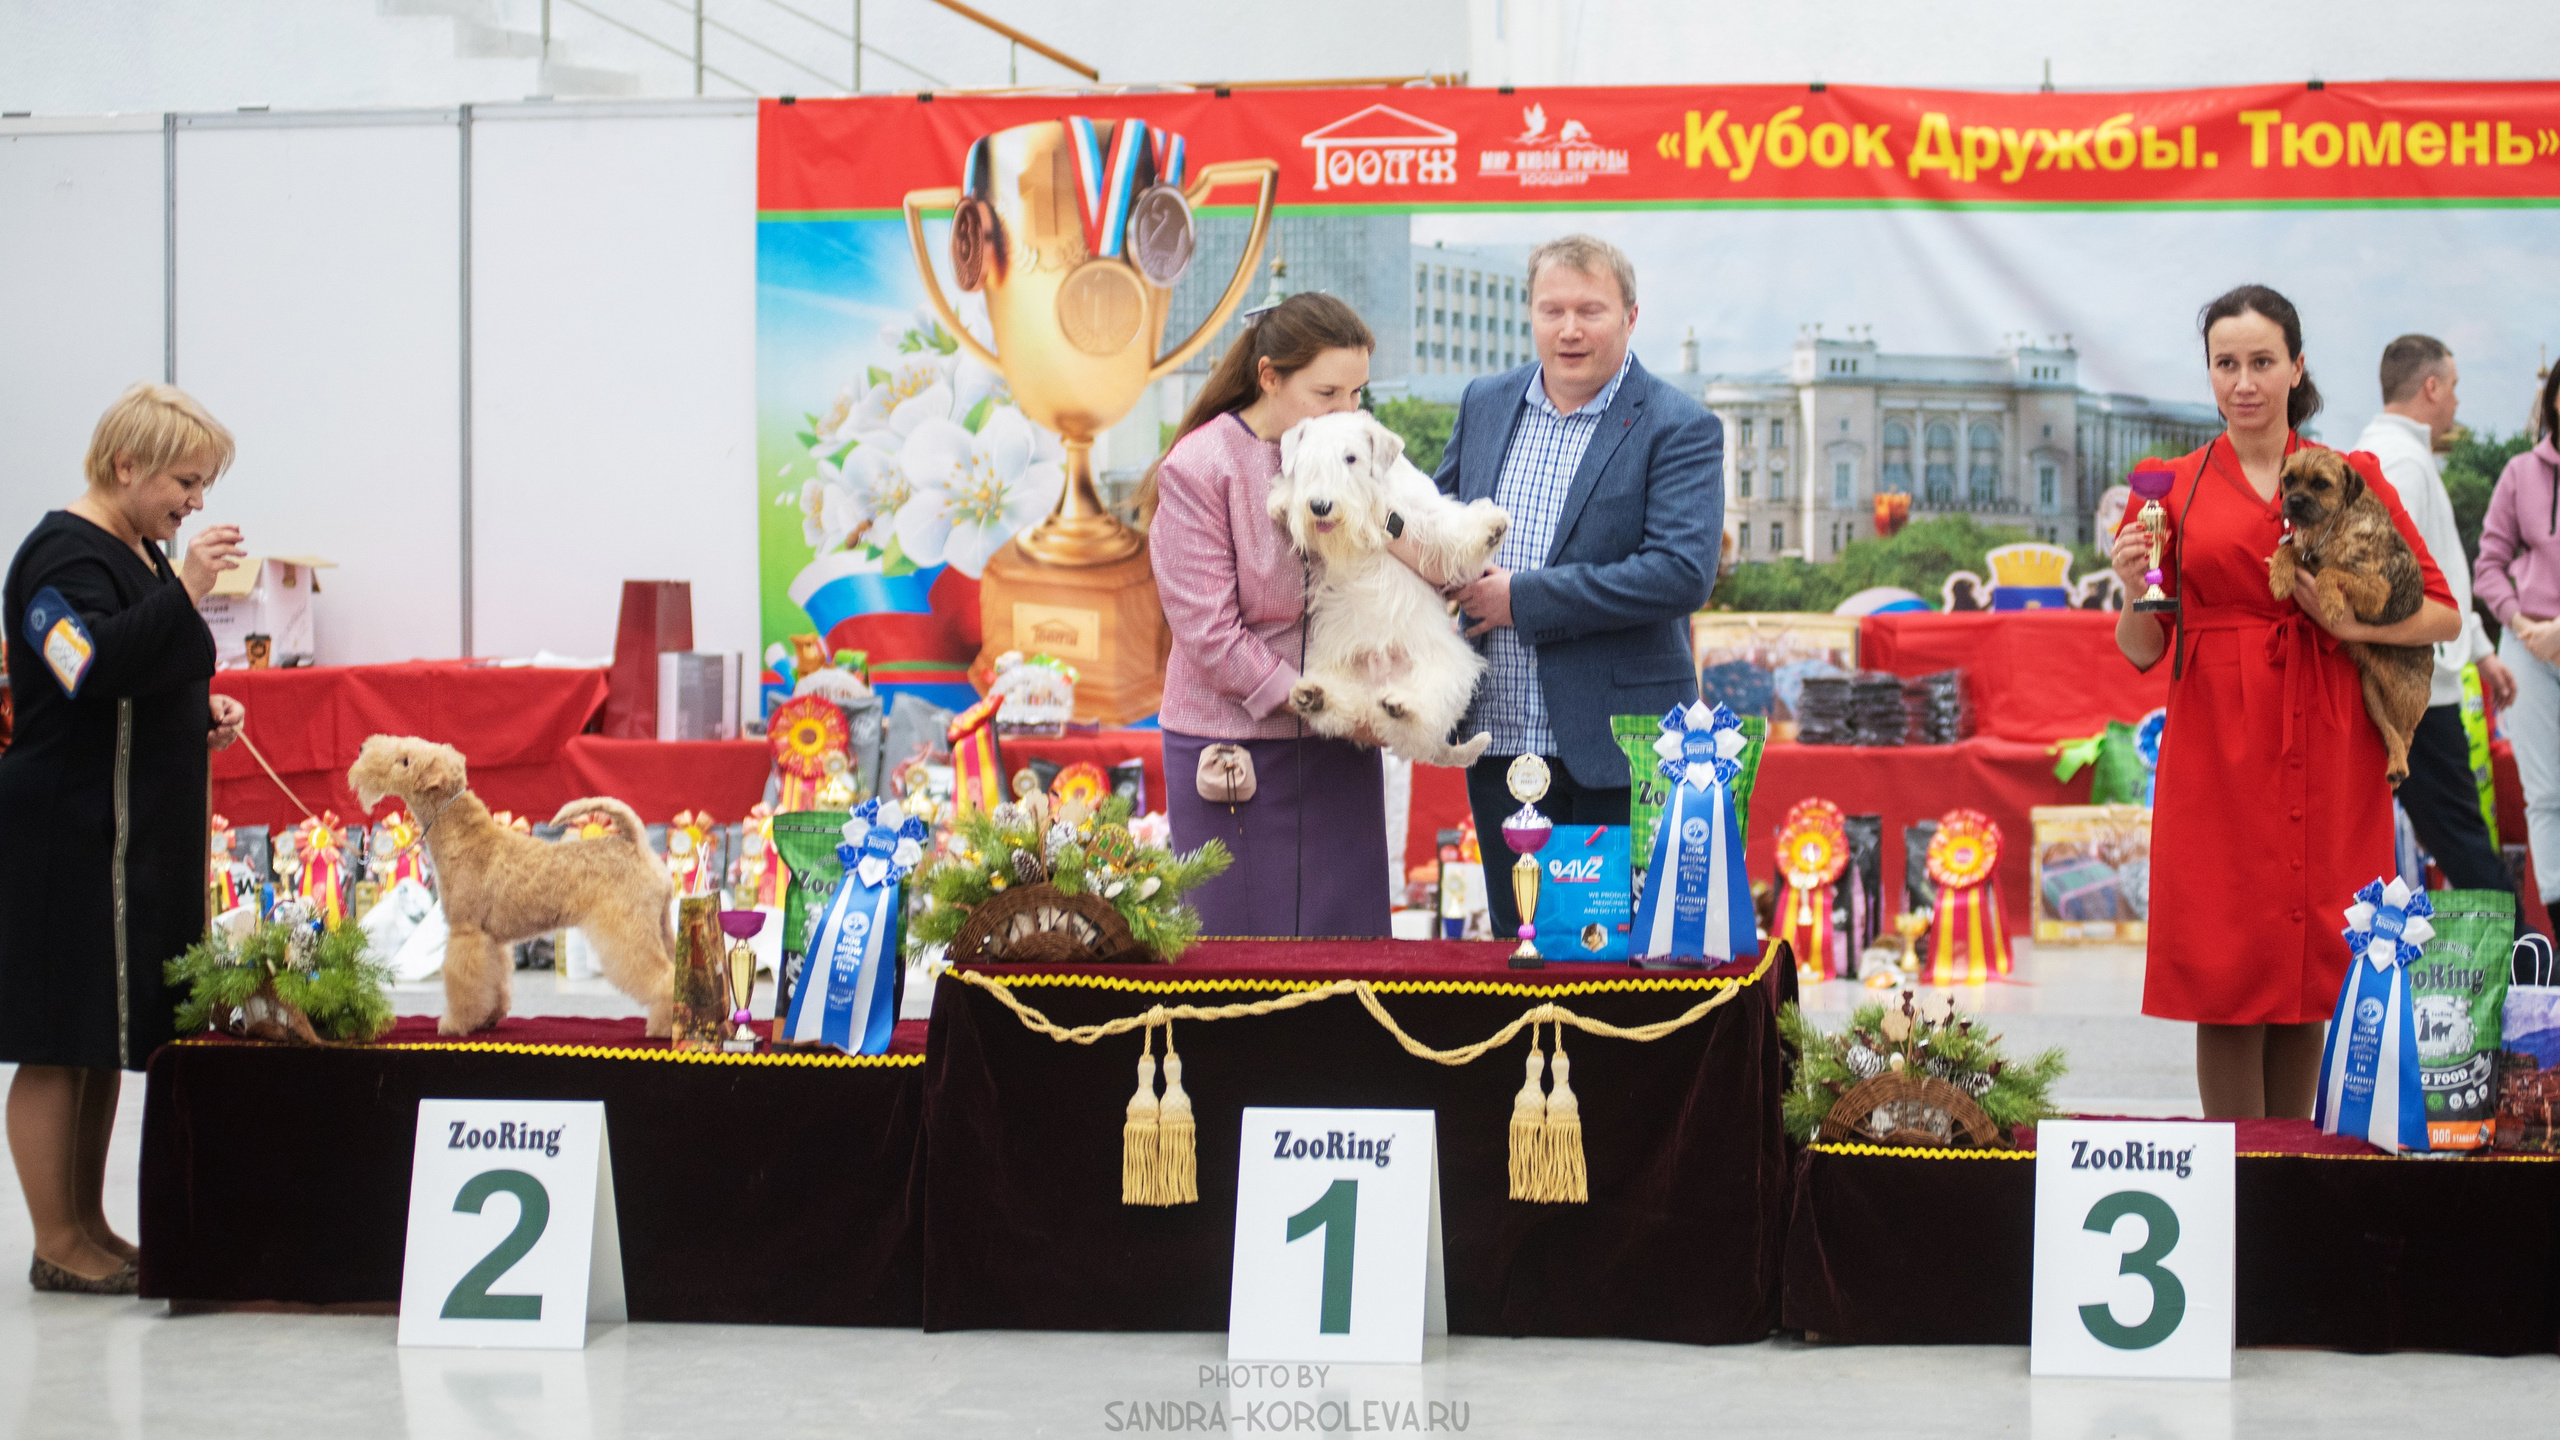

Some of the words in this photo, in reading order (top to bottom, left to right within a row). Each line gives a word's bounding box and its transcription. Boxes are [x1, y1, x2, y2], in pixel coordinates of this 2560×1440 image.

[1657, 106, 1894, 181] «Кубок
[1907, 111, 2218, 182] Дружбы.
[2238, 109, 2560, 168] Тюмень»
[1556, 858, 1604, 880] AVZ
[2433, 1067, 2468, 1085] FOOD
[448, 1121, 562, 1158] ZooRing
[1273, 1130, 1393, 1168] ZooRing
[2432, 1128, 2451, 1144] DOG
[2071, 1140, 2193, 1179] ZooRing
[439, 1169, 550, 1321] 2
[1285, 1179, 1359, 1334] 1
[2078, 1191, 2186, 1350] 3
